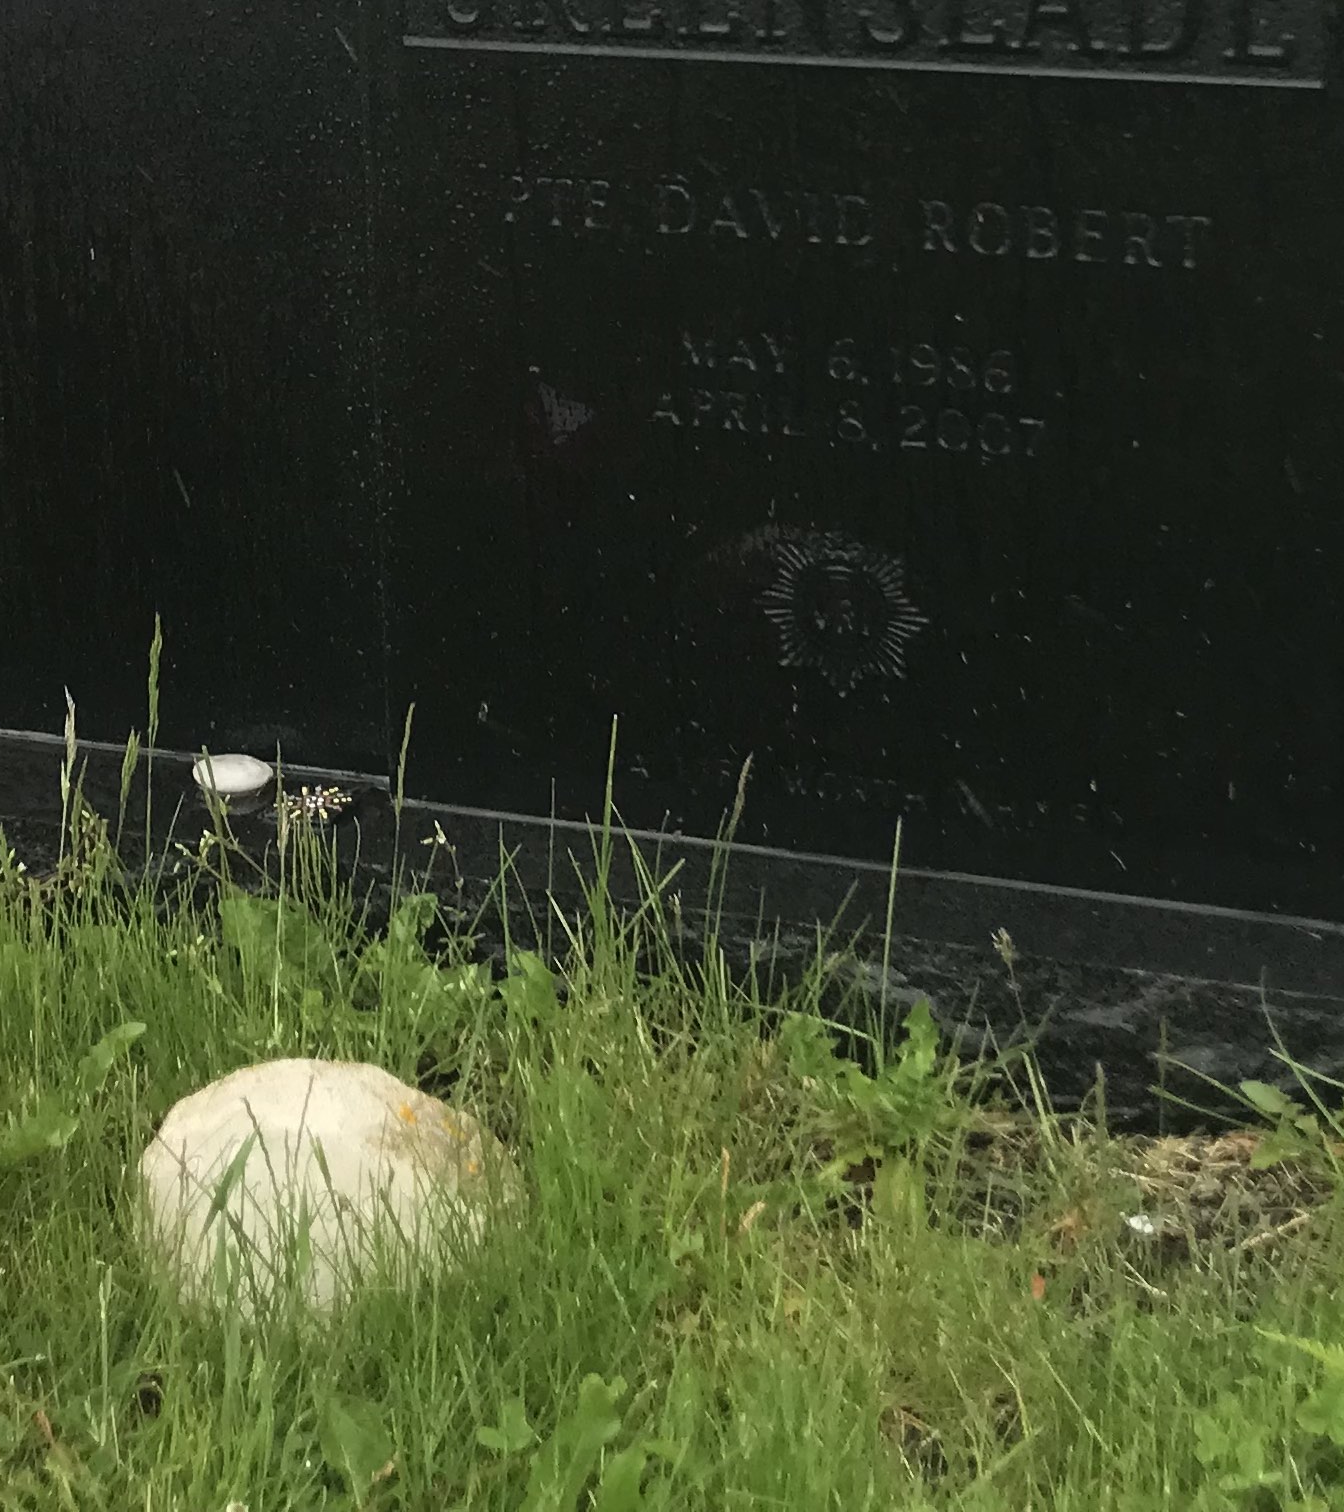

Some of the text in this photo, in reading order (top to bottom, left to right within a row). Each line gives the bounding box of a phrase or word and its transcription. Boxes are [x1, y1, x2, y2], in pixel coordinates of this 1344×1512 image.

[654, 181, 875, 248] DAVID
[917, 198, 1215, 270] ROBERT
[888, 341, 1016, 396] 1986
[646, 388, 808, 439] APRIL
[898, 402, 1048, 459] 2007
